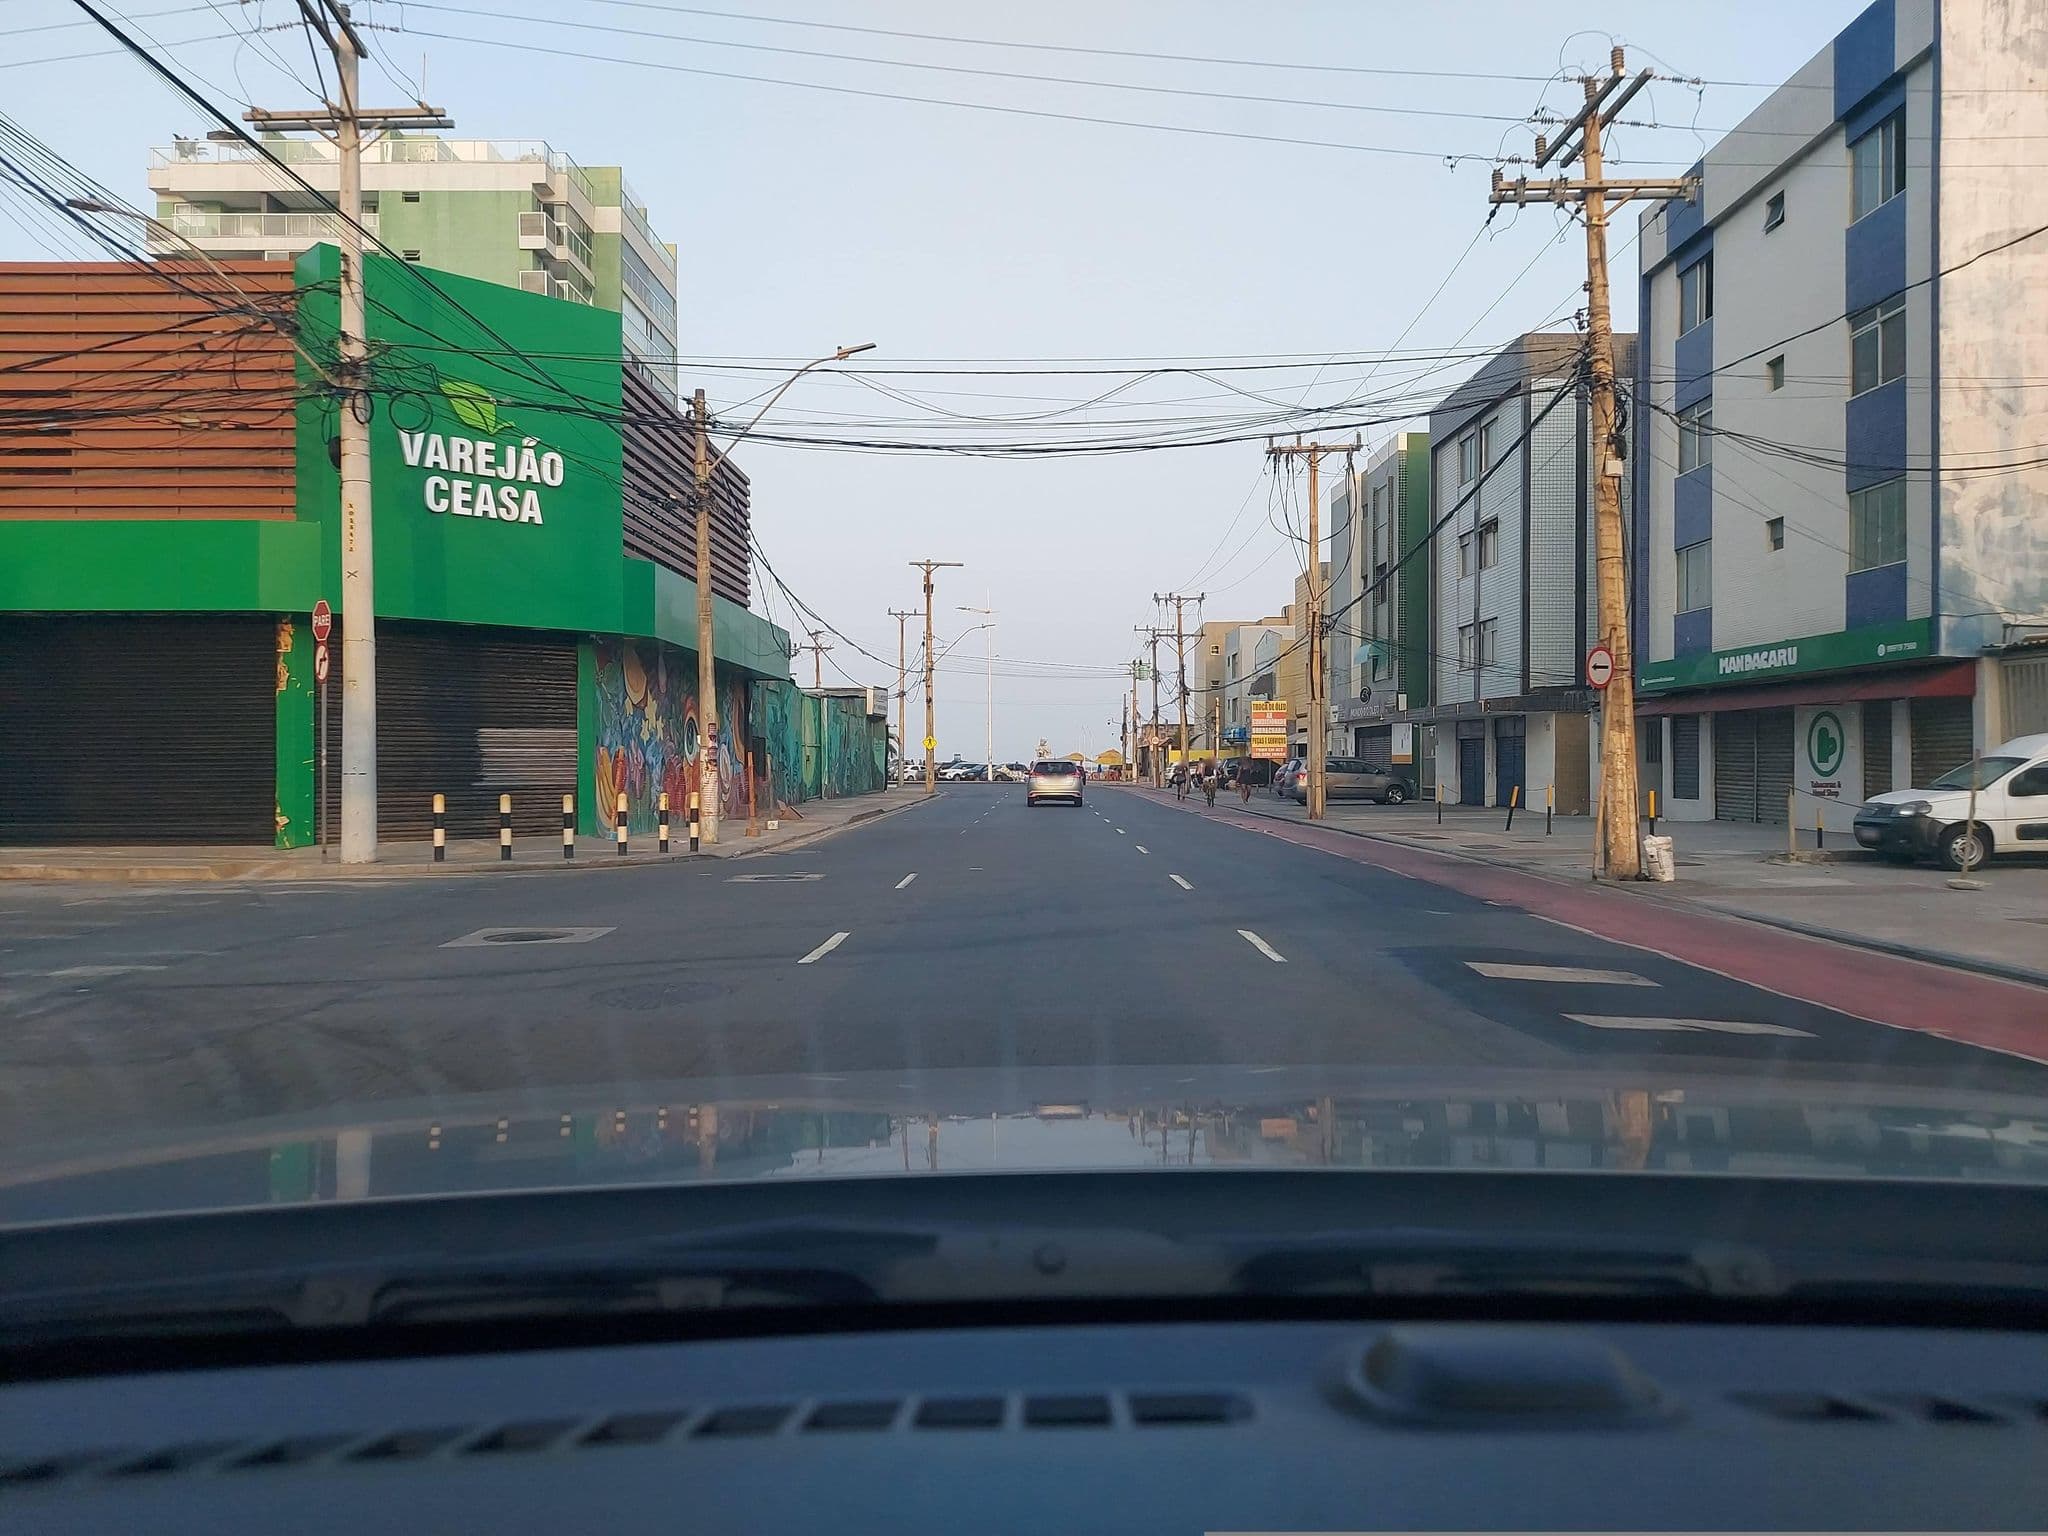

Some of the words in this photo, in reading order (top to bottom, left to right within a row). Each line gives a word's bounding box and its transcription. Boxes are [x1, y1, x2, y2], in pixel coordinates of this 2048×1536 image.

[399, 429, 564, 487] VAREJÃO
[424, 475, 544, 525] CEASA
[313, 614, 330, 627] PARE
[1719, 646, 1798, 674] MANDACARU
